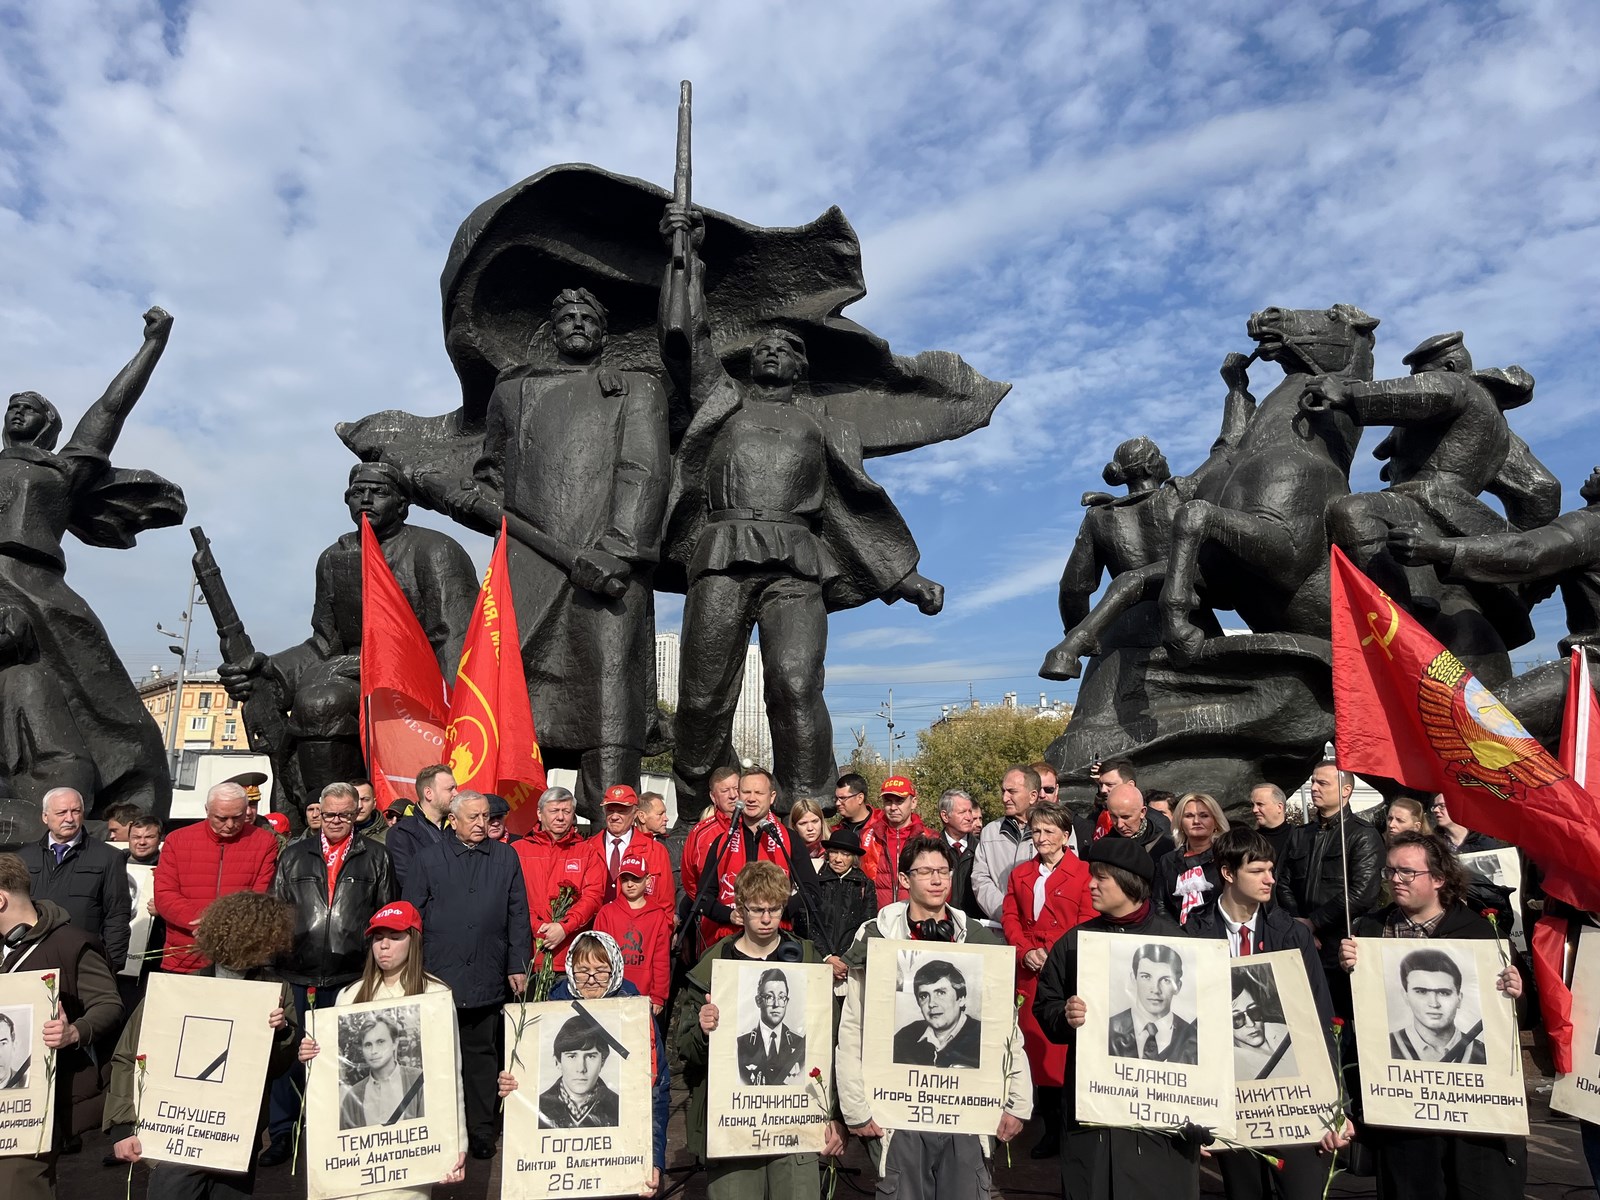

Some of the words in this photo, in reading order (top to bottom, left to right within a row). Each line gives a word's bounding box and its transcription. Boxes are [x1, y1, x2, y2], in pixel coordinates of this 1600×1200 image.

[884, 780, 905, 789] СССР
[623, 953, 645, 966] ССР
[908, 1069, 960, 1090] ПАПИН
[1114, 1062, 1188, 1088] ЧЕЛЯКОВ
[1387, 1065, 1485, 1088] ПАНТЕЛЕЕВ
[732, 1091, 809, 1110] КЛЮЧНИКОВ
[873, 1087, 912, 1102] ИГОРЬ
[918, 1090, 1001, 1107] ВЯЧЕСЛАВОВИЧ
[1089, 1080, 1139, 1098] НИКОЛАЙ
[1146, 1087, 1219, 1108] НИКОЛАЕВИЧ
[1370, 1083, 1413, 1099] ИГОРЬ
[1420, 1087, 1524, 1107] ВЛАДИМИРОВИЧ
[157, 1100, 227, 1126] СОКУШЕВ
[907, 1105, 934, 1123] 38
[936, 1113, 960, 1125] ЛЕТ
[1129, 1102, 1151, 1121] 43
[1154, 1111, 1191, 1126] ГОДА
[1276, 1103, 1333, 1117] ЮРЬЕВИЧ
[1413, 1102, 1440, 1121] 20
[1443, 1110, 1469, 1123] ЛЕТ
[139, 1118, 184, 1136] АНАТОЛИЙ
[187, 1124, 240, 1143] СЕМЕНОВИЧ
[718, 1114, 756, 1128] ЛЕОНИД
[1245, 1121, 1274, 1139] 23
[1279, 1125, 1311, 1139] ГОДА
[166, 1137, 184, 1156] 48
[184, 1146, 203, 1159] ЛЕТ
[337, 1125, 429, 1152] ТЕМЛЯНЦЕВ
[541, 1135, 612, 1154] ГОГОЛЕВ
[752, 1129, 771, 1151] 54
[773, 1134, 799, 1147] ГОДА
[325, 1154, 360, 1171] ЮРИЙ
[366, 1143, 441, 1165] АНАТОЛЬЕВИЧ
[517, 1159, 556, 1172] ВИКТОР
[566, 1155, 644, 1169] ВАЛЕНТИНОВИЧ
[361, 1165, 386, 1186] 30
[388, 1168, 408, 1182] ЛЕТ
[548, 1173, 574, 1191] 26
[576, 1177, 601, 1190] ЛЕТ
